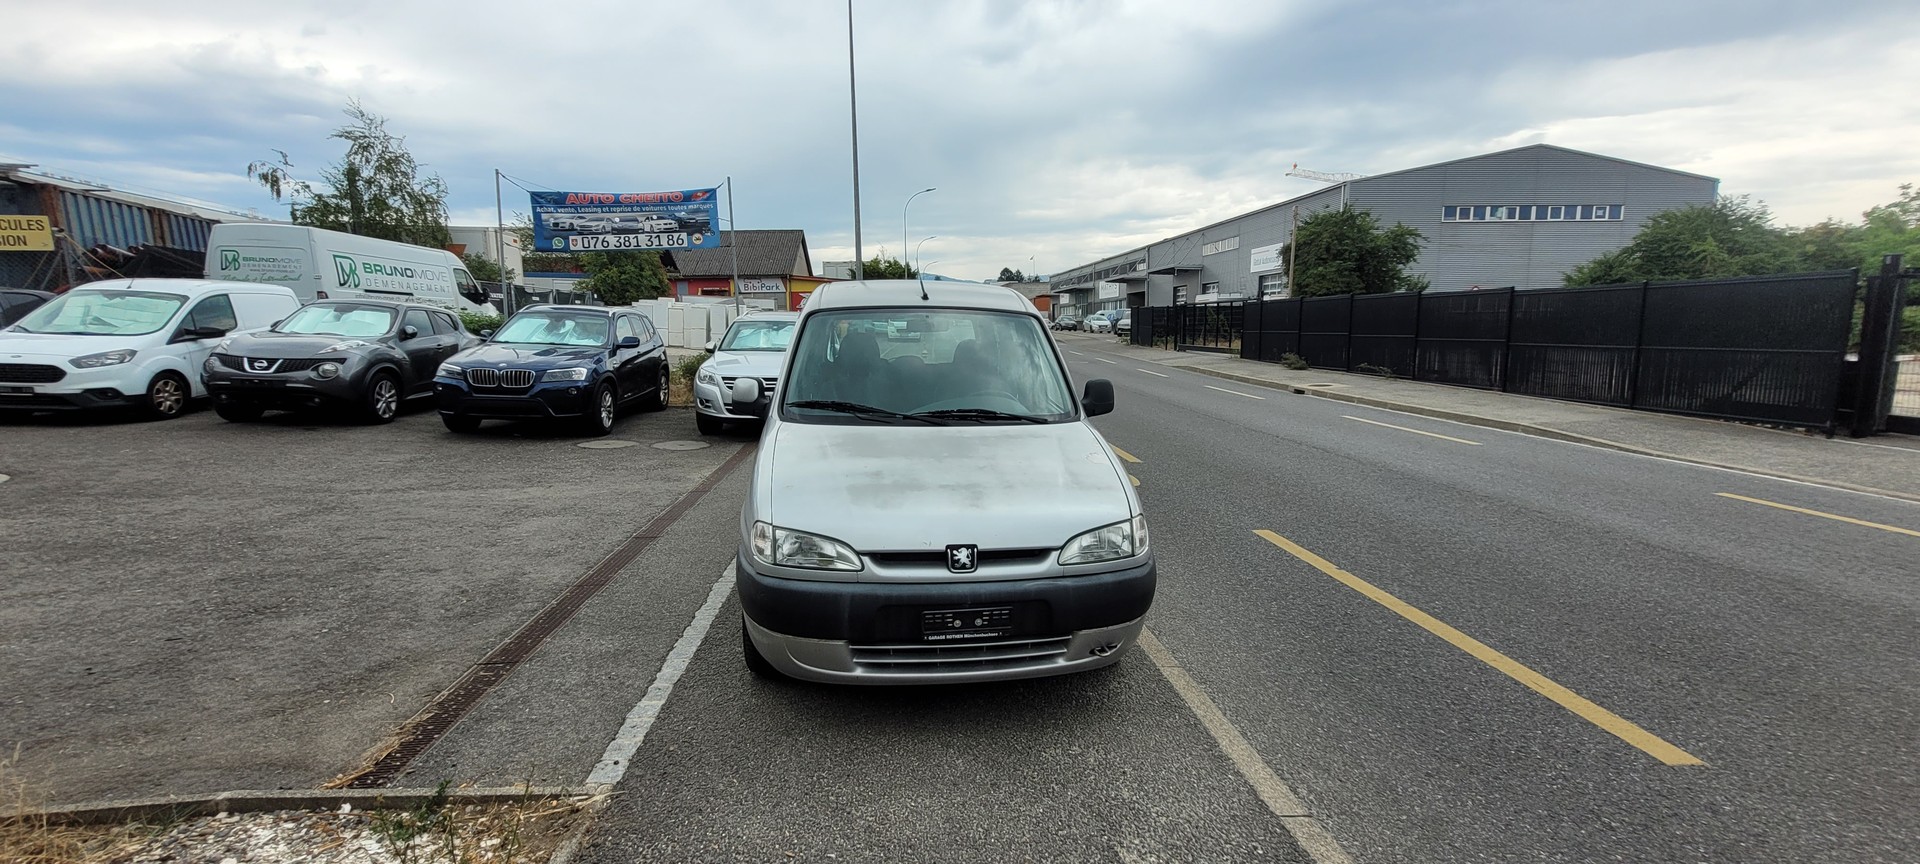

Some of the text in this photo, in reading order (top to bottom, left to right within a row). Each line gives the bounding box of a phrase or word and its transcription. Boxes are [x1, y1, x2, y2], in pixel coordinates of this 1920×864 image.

[566, 192, 615, 205] AUTO
[578, 206, 602, 214] Leasing
[610, 206, 632, 214] reprise
[642, 204, 667, 212] voitures
[668, 203, 688, 211] toutes
[688, 202, 714, 211] marques
[0, 235, 27, 247] ION
[581, 234, 685, 249] 076 381 31 86
[362, 262, 449, 283] BRUNOMOVE
[365, 276, 451, 293] DÉMÉNAGEMENT
[744, 283, 781, 291] BibiPark
